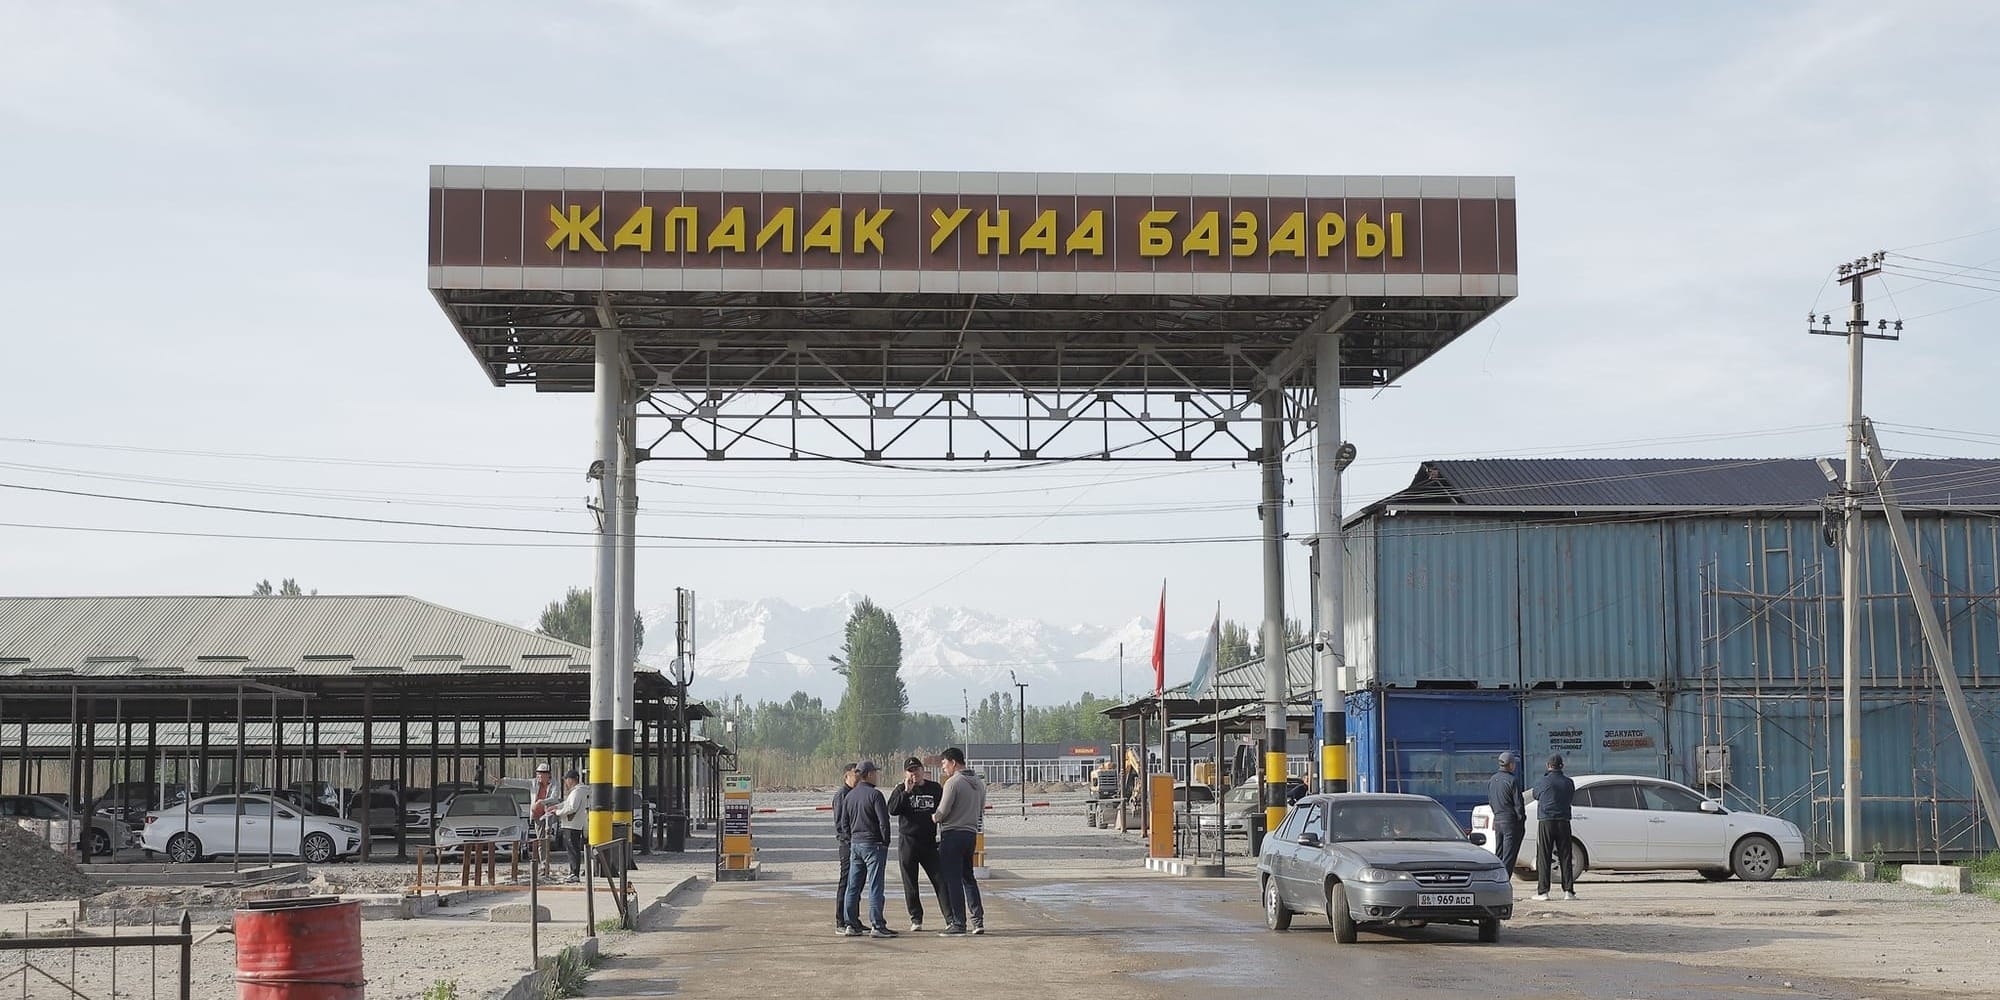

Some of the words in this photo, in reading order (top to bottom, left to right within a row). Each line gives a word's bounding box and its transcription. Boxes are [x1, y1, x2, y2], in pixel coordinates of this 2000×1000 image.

[545, 204, 894, 254] ЖАПАЛАК
[930, 208, 1104, 256] УНАА
[1139, 210, 1404, 258] БАЗАРЫ
[1437, 895, 1454, 904] 969
